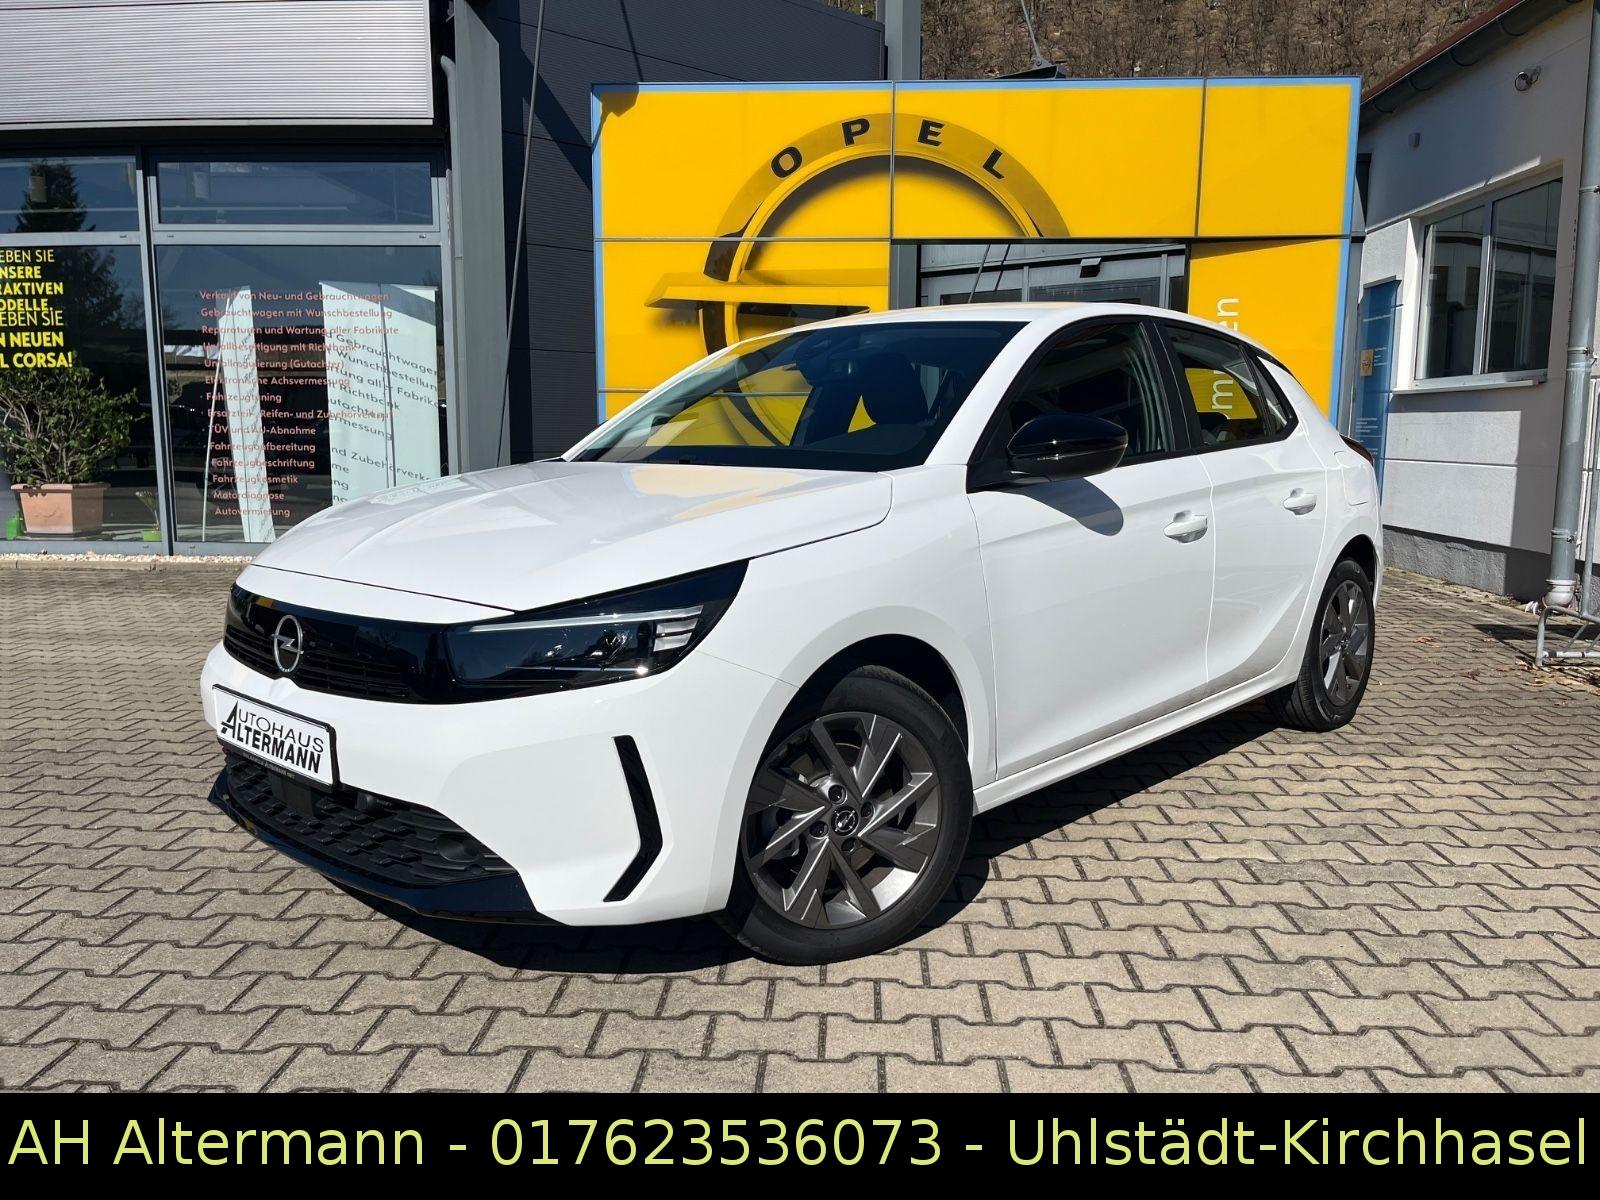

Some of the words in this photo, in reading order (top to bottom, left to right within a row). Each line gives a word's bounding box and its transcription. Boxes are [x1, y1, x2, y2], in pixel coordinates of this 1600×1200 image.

[770, 118, 1005, 179] OPEL
[36, 249, 55, 262] SIE
[200, 290, 237, 299] Verkauf
[239, 292, 256, 300] von
[260, 292, 281, 300] Neu-
[285, 291, 303, 300] und
[306, 292, 389, 303] Gebrauchtwagen
[42, 310, 65, 326] SIE
[201, 308, 284, 319] Gebrauchtwagen
[287, 308, 302, 317] mit
[306, 309, 392, 319] Wunschbestellung
[202, 326, 262, 336] Reparaturen
[265, 327, 283, 335] und
[286, 326, 327, 337] Wartung
[332, 326, 350, 335] aller
[354, 326, 399, 335] Fabrikate
[10, 331, 64, 347] NEUEN
[291, 343, 306, 351] mit
[309, 343, 356, 352] Richtbank
[13, 352, 73, 368] CORSA!
[290, 360, 345, 370] (Gutachter)
[270, 376, 350, 387] Achsvermessung
[206, 393, 282, 404] Fahrzeugtuning
[260, 409, 294, 418] Reifen-
[296, 409, 314, 418] und
[208, 423, 228, 434] TÜV
[232, 426, 250, 434] und
[253, 426, 316, 435] AU-Abnahme
[209, 442, 316, 453] Fahrzeugaufbereitung
[211, 458, 315, 469] Fahrzeugbeschriftung
[212, 475, 298, 485] Fahrzeugkosmetik
[213, 491, 285, 501] Motordiagnose
[215, 507, 291, 517] Autovermietung
[221, 700, 324, 753] AUTOHAUS
[221, 700, 321, 774] ALTERMANN
